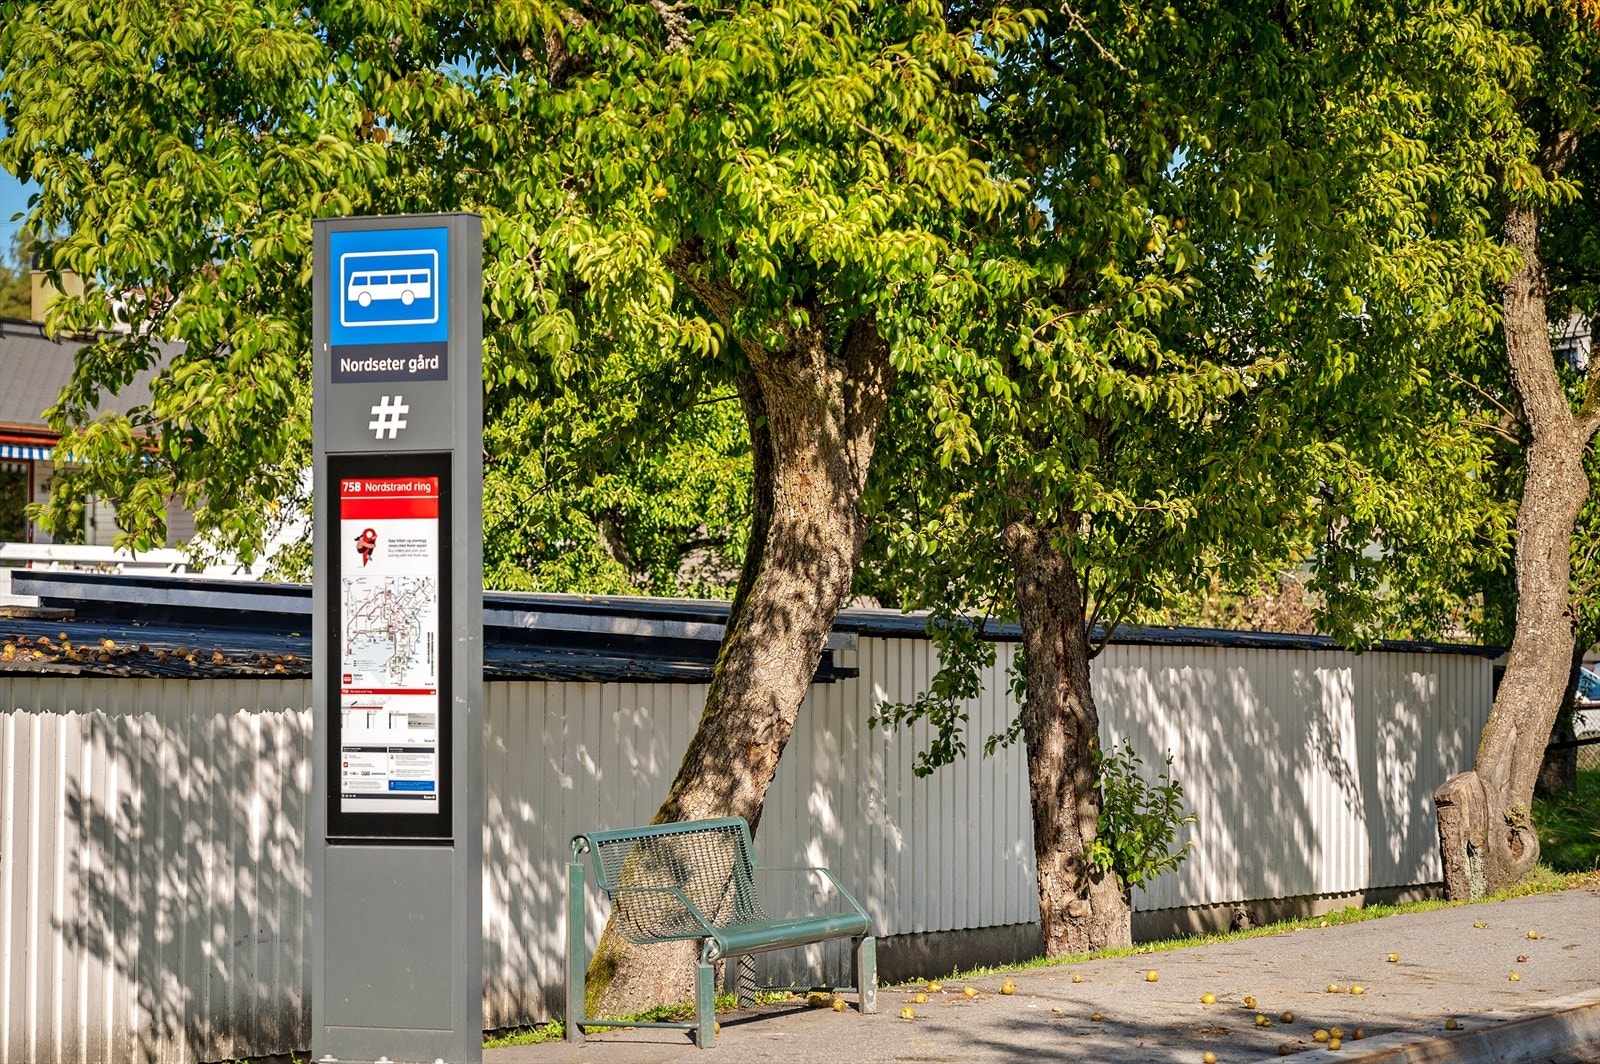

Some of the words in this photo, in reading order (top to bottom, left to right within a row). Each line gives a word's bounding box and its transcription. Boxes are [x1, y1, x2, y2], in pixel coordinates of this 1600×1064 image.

[340, 357, 406, 372] Nordseter
[408, 354, 439, 374] gård
[368, 396, 410, 439] #
[342, 482, 362, 492] 75B
[365, 482, 412, 492] Nordstrand
[414, 482, 431, 493] ring
